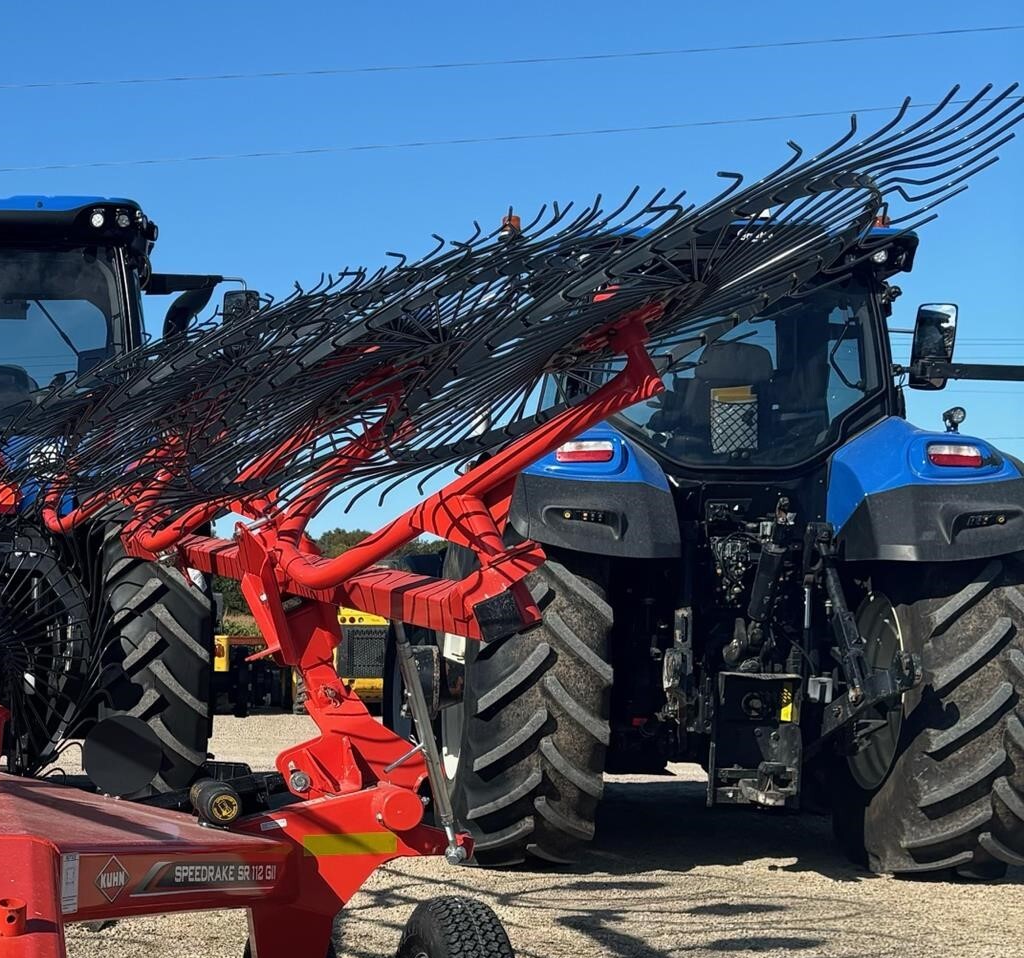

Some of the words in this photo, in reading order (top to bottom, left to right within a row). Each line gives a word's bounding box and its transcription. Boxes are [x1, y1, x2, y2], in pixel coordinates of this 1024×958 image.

[100, 871, 125, 889] KUHN
[174, 864, 235, 882] SPEEDRAKE
[237, 865, 250, 880] SR
[251, 865, 264, 880] 112
